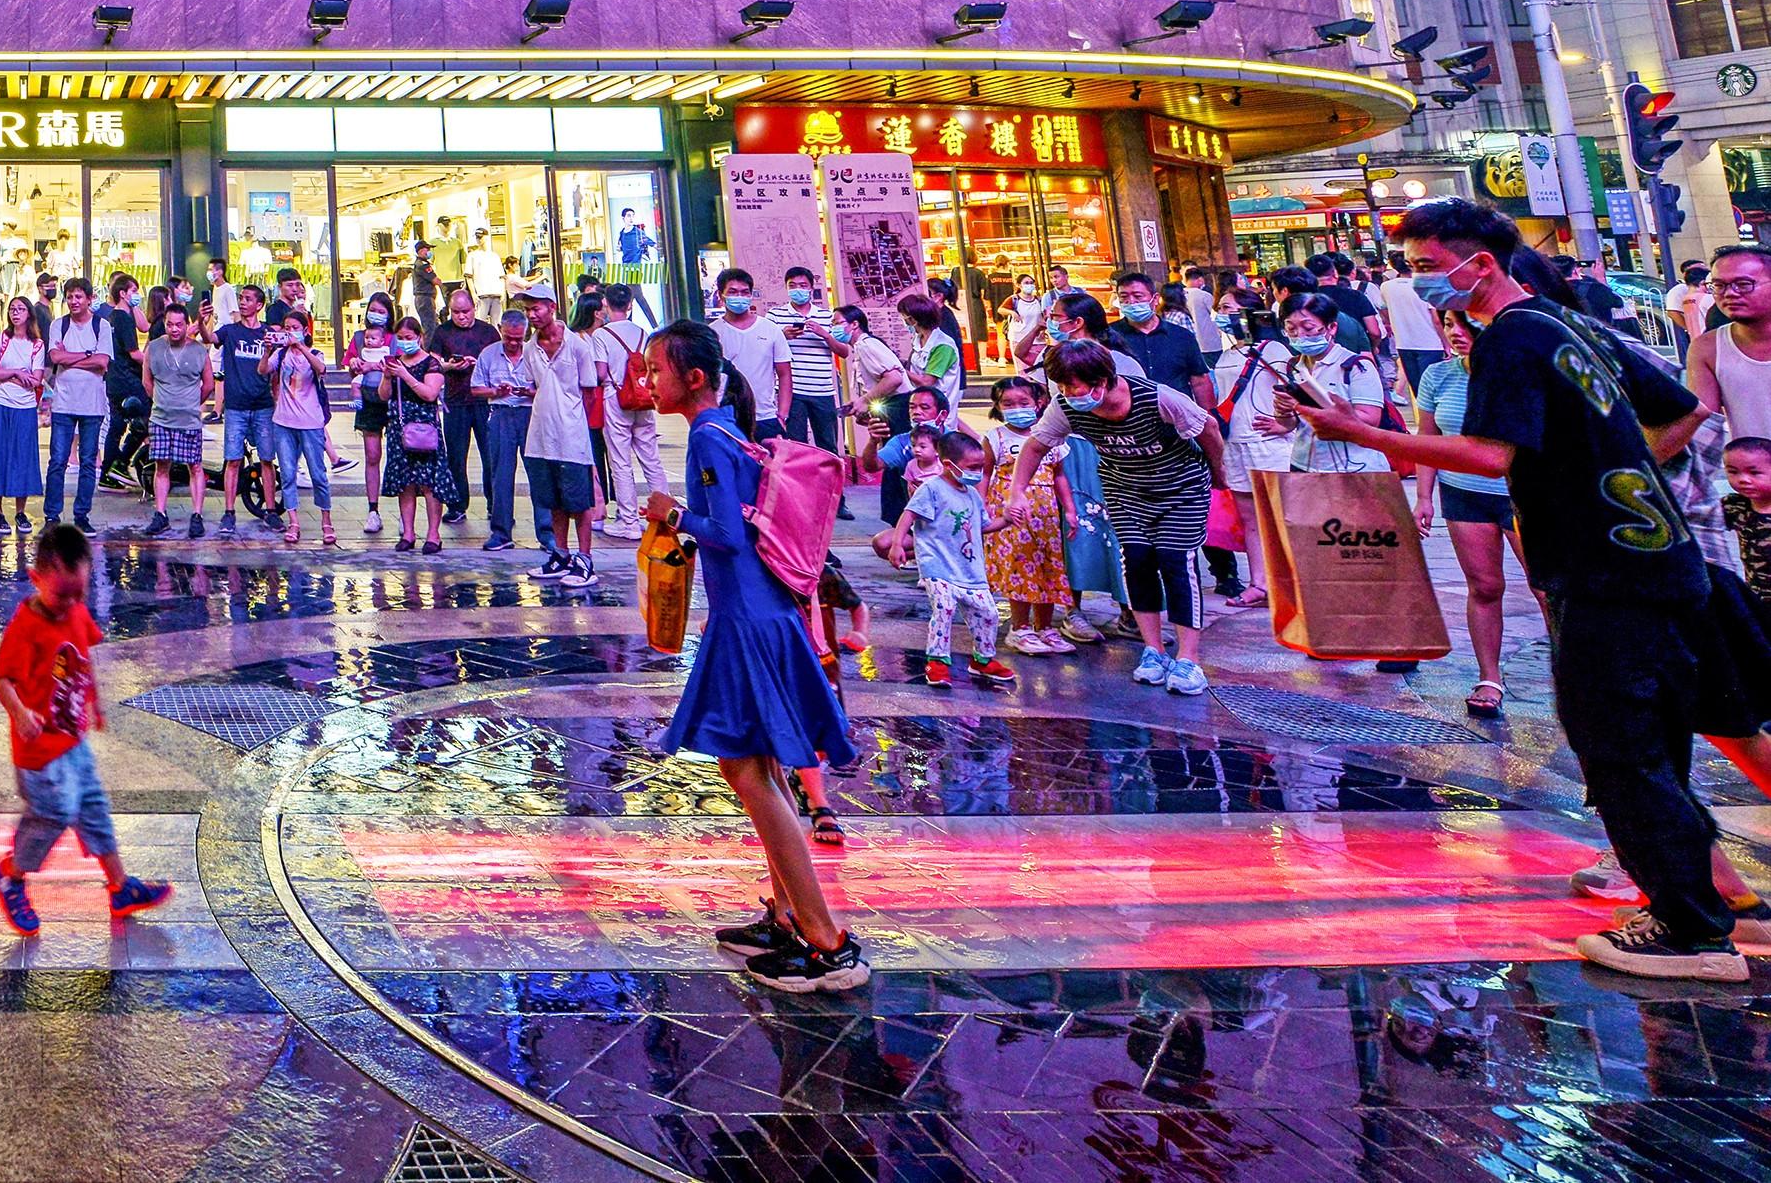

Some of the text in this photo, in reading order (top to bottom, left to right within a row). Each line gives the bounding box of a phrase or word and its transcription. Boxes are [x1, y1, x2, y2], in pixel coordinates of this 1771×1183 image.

[36, 110, 125, 149] 森馬
[884, 114, 1018, 157] 蓮香樓
[734, 188, 811, 197] 景区攻略
[834, 186, 911, 196] 景点导览
[1103, 435, 1136, 445] TAN
[1317, 518, 1400, 547] Sanse
